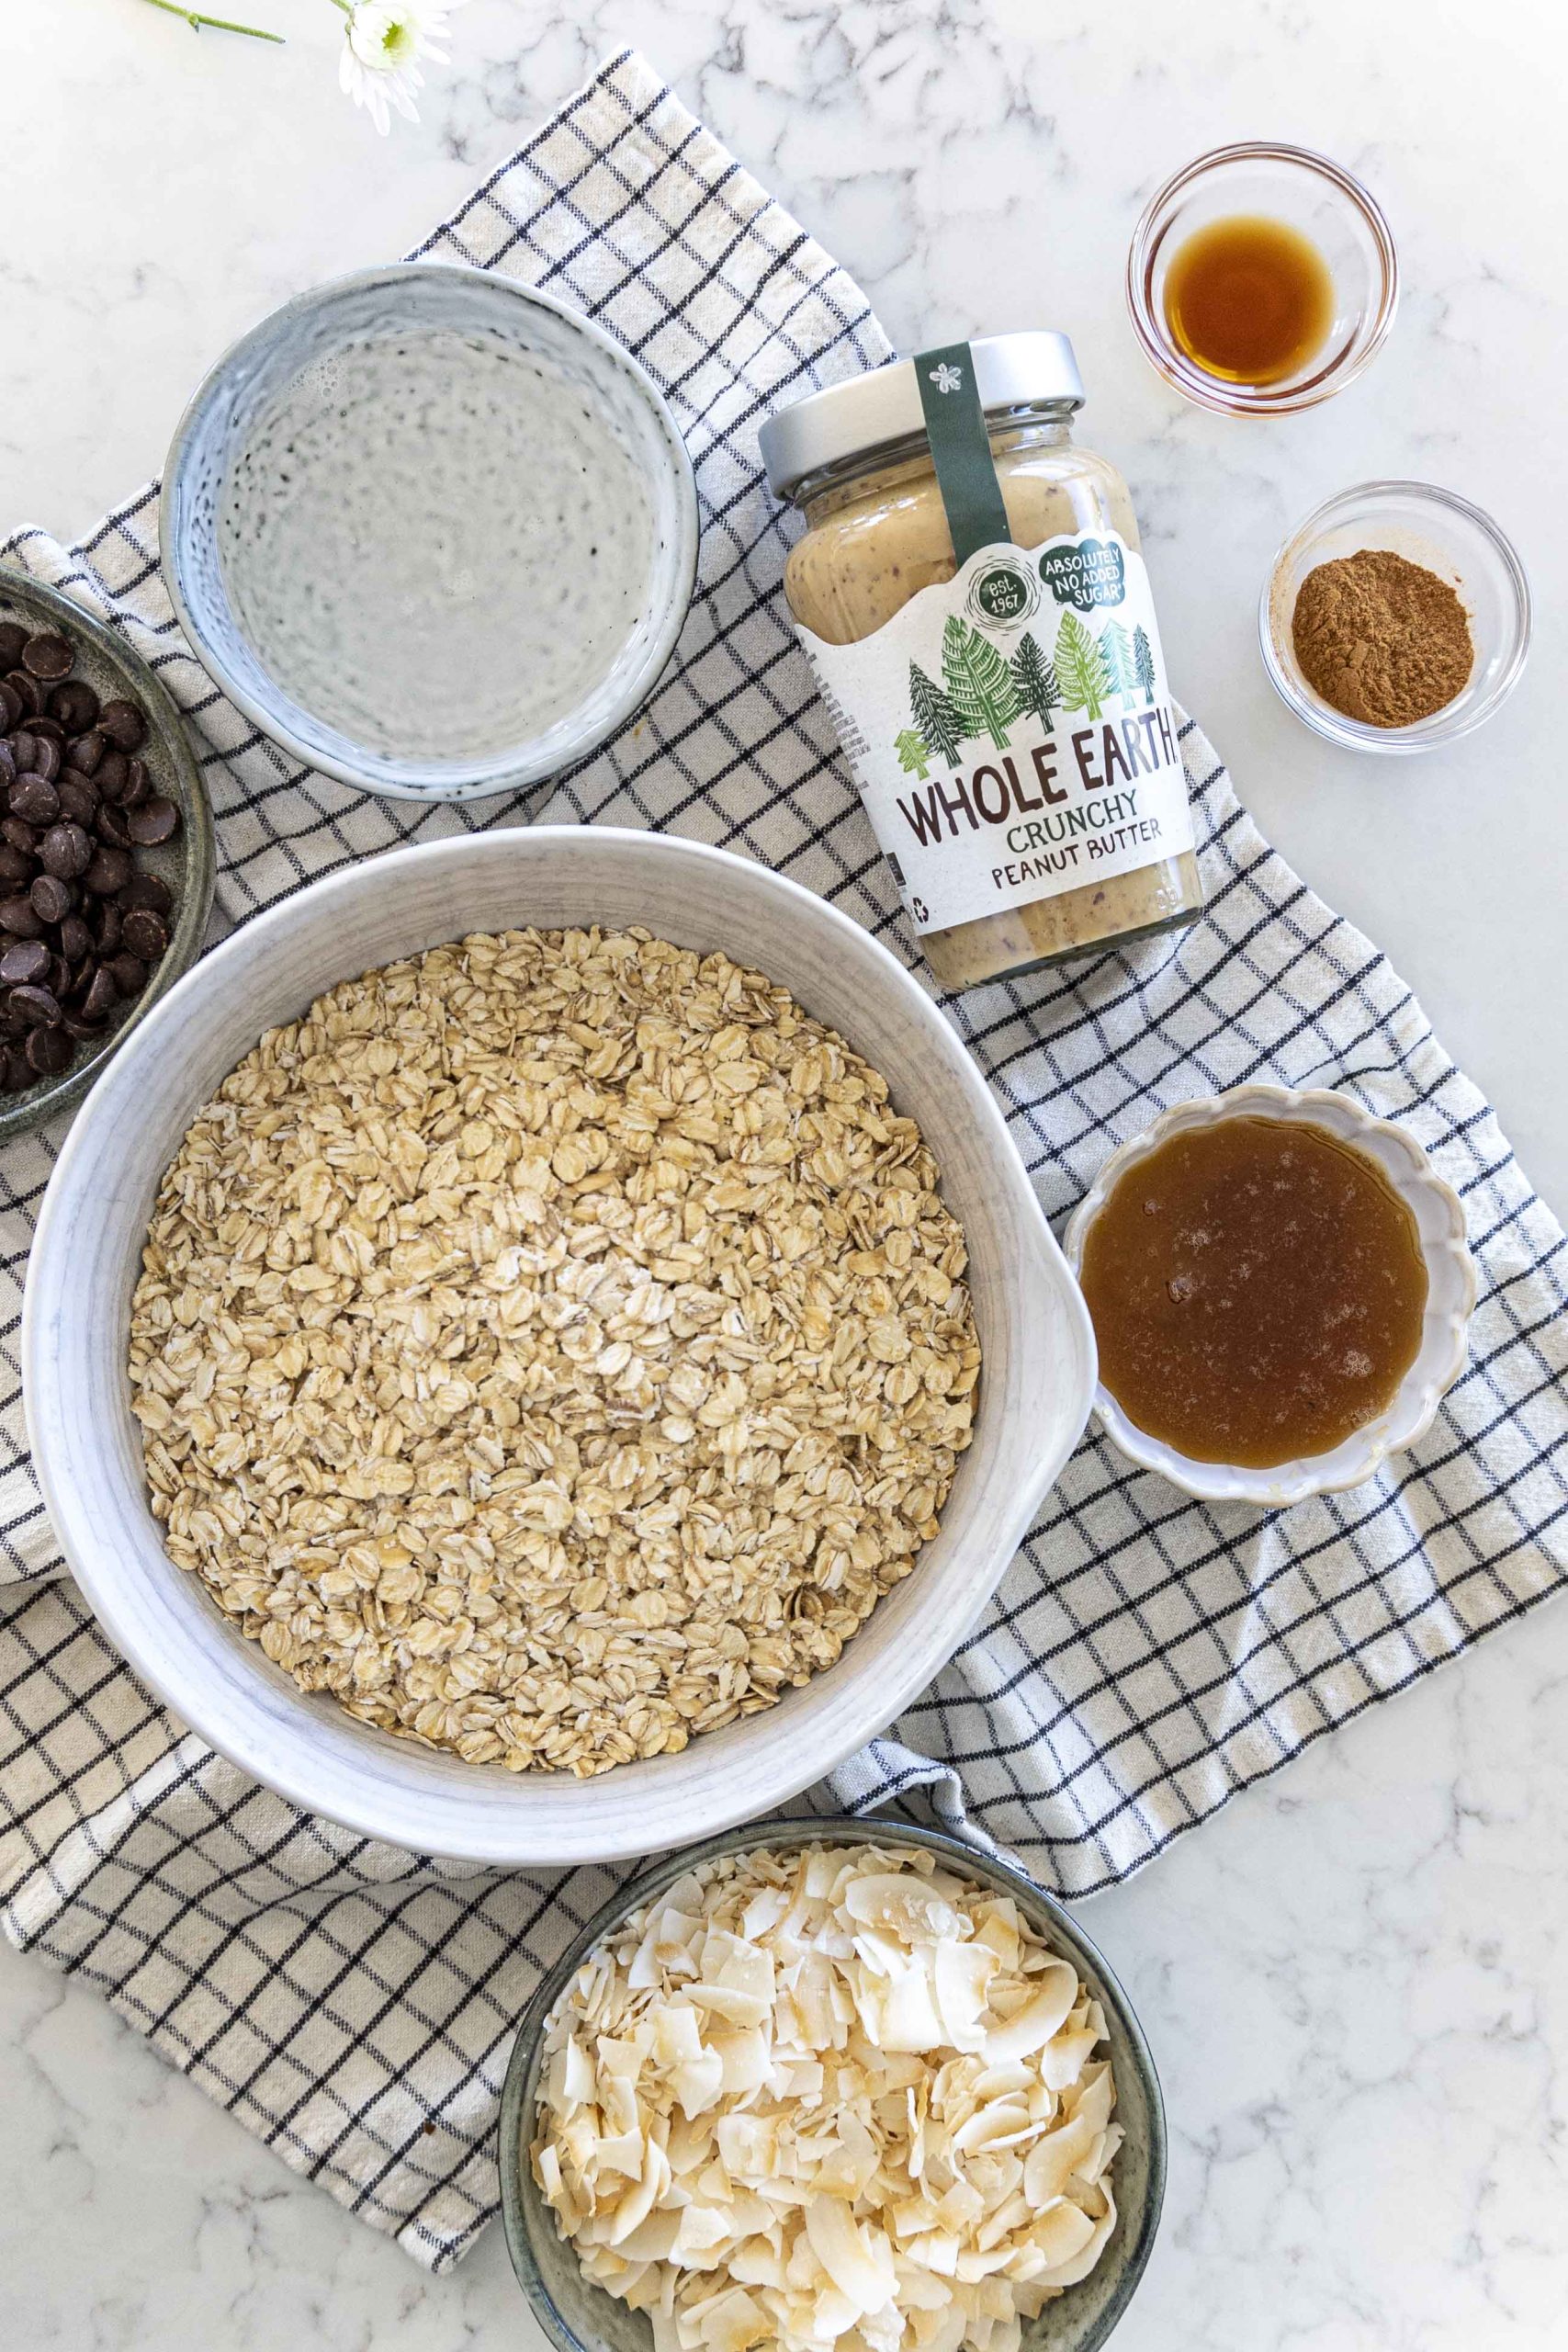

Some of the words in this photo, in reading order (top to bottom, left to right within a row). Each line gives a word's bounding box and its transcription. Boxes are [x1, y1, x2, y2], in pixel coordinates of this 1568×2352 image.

[1045, 548, 1120, 576] ABSOLUTELY
[988, 575, 1017, 597] est.
[1055, 574, 1079, 594] NO
[1082, 567, 1120, 586] ADDED
[990, 594, 1019, 614] 1967
[897, 742, 1068, 847] WHOLE
[1071, 707, 1177, 791] EARTH
[1007, 789, 1138, 854] CRUNCHY
[992, 843, 1078, 889] PEANUT
[1087, 818, 1162, 860] BUTTER
